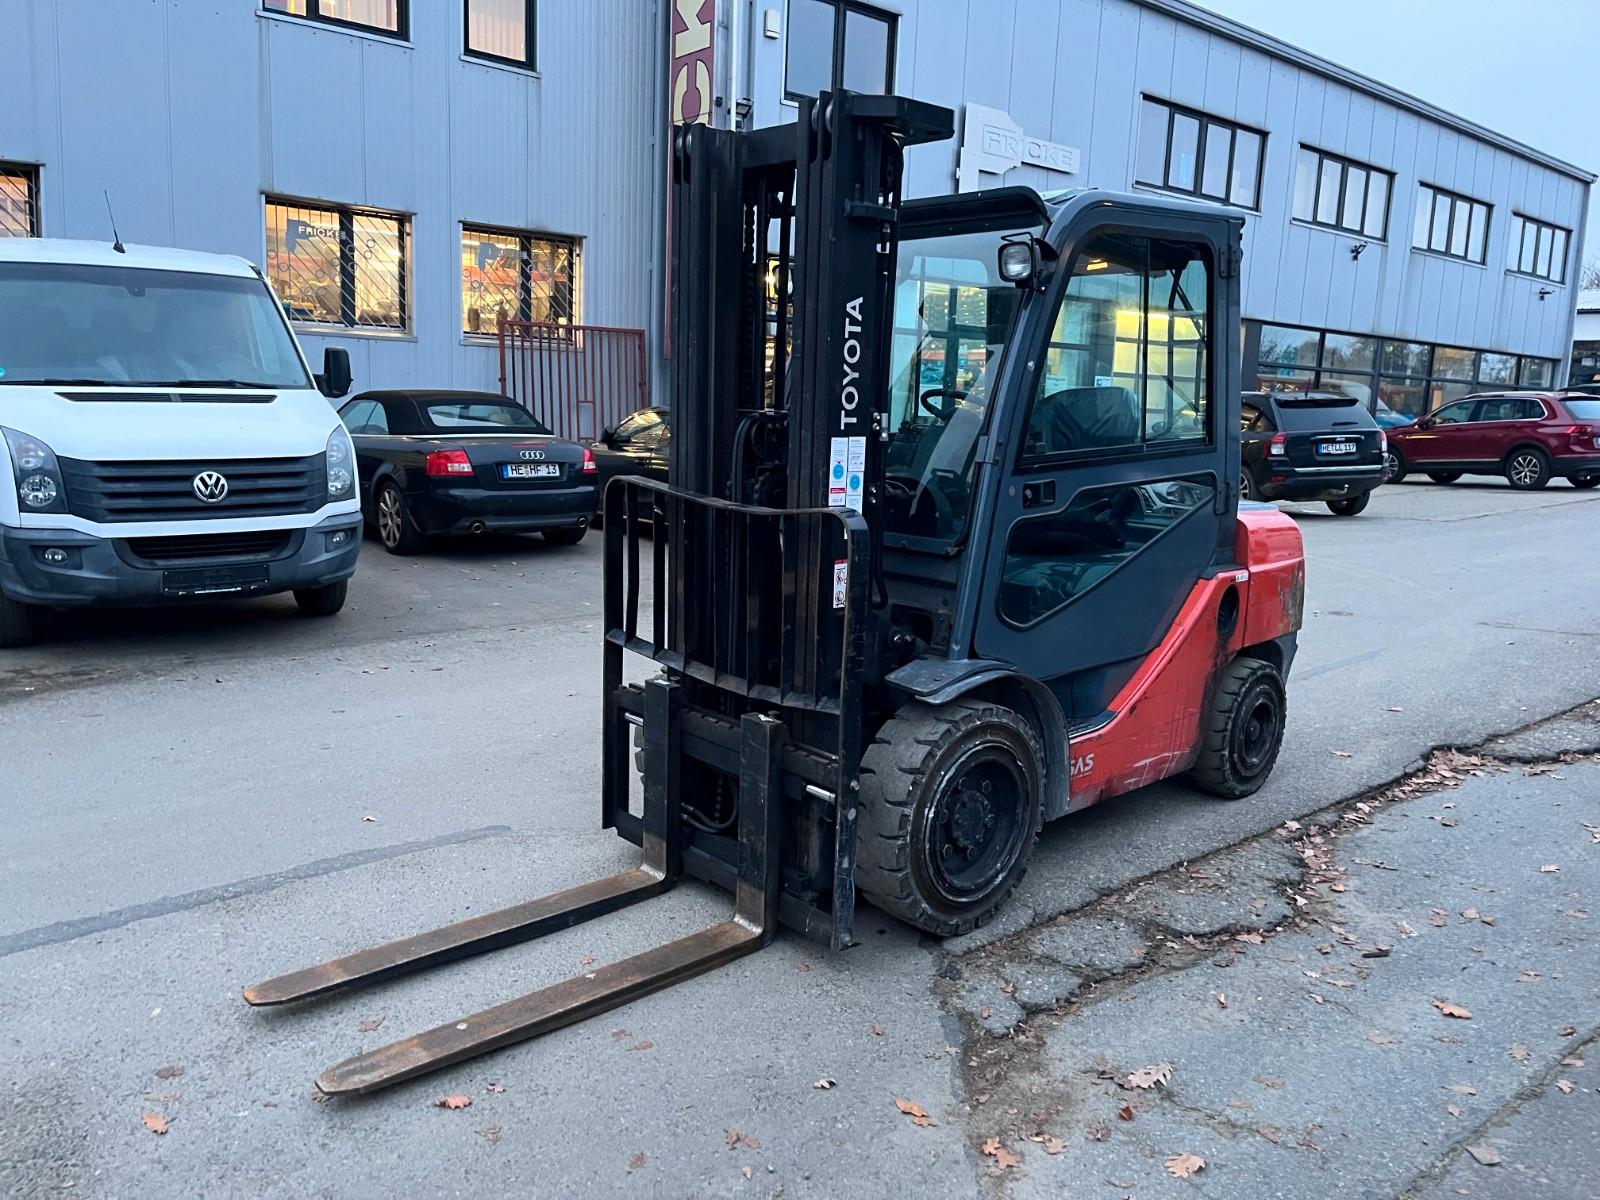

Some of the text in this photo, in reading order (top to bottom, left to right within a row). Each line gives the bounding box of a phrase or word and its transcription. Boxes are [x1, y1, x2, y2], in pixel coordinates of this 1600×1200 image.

[984, 131, 1073, 168] FRICKE
[841, 296, 864, 430] TOYOTA
[511, 464, 557, 475] HE HF 13
